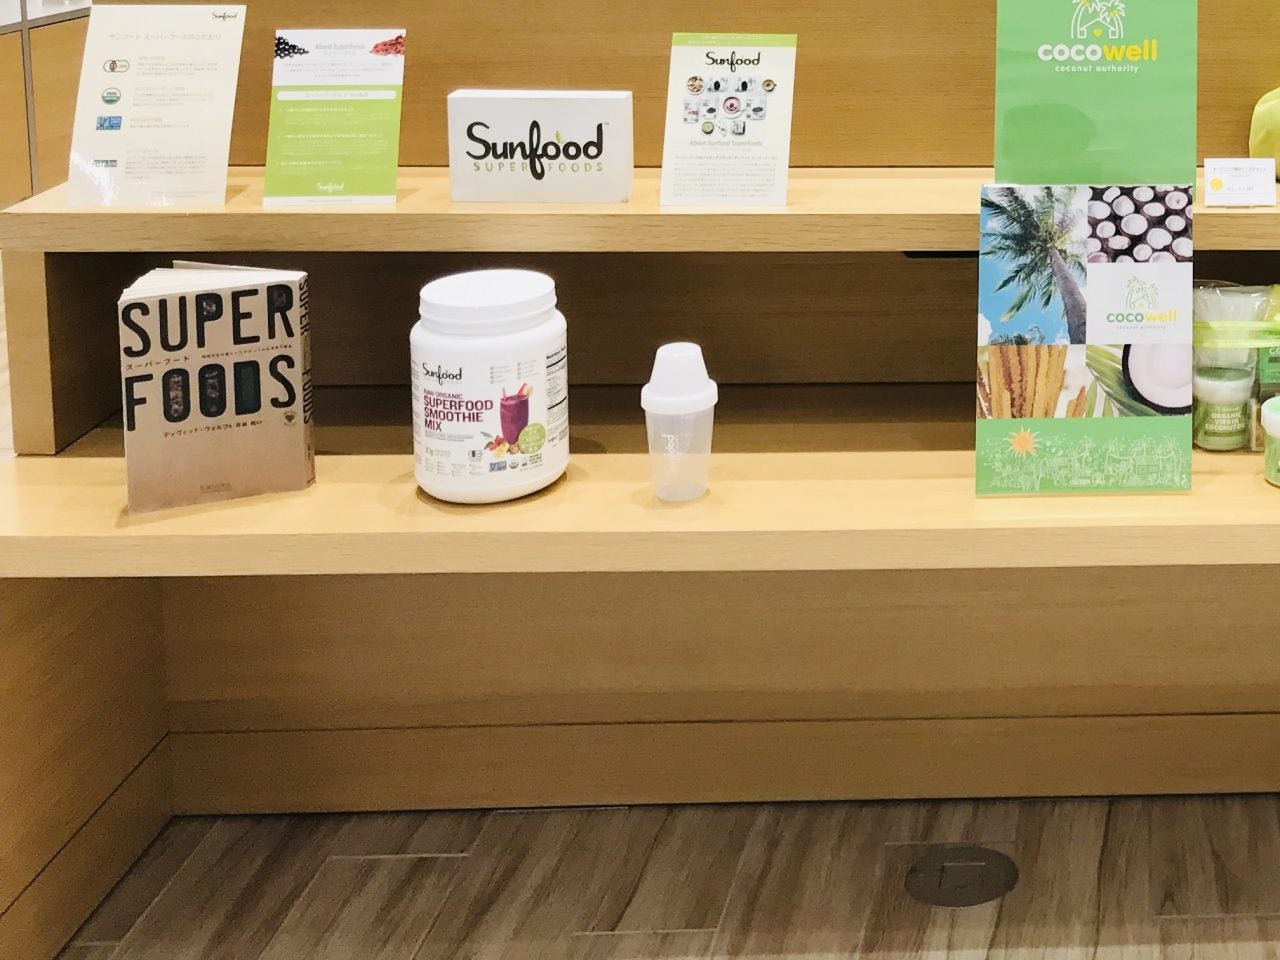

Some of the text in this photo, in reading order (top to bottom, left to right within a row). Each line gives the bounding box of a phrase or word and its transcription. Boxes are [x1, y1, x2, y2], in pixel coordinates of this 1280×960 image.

[1037, 39, 1158, 62] cocowell
[705, 50, 761, 73] Sunfood
[1054, 64, 1139, 74] coconut authority
[465, 120, 604, 181] Sunfood
[472, 161, 604, 173] SUPER FOODS
[121, 283, 295, 358] SUPER
[1106, 309, 1177, 323] cocowell
[125, 355, 191, 371] スーパーフード
[422, 362, 462, 386] Sunfood
[125, 354, 297, 432] FOODS
[423, 395, 494, 412] SUPERFOOD
[424, 406, 484, 423] SMOOTHIE
[424, 419, 442, 432] MIX
